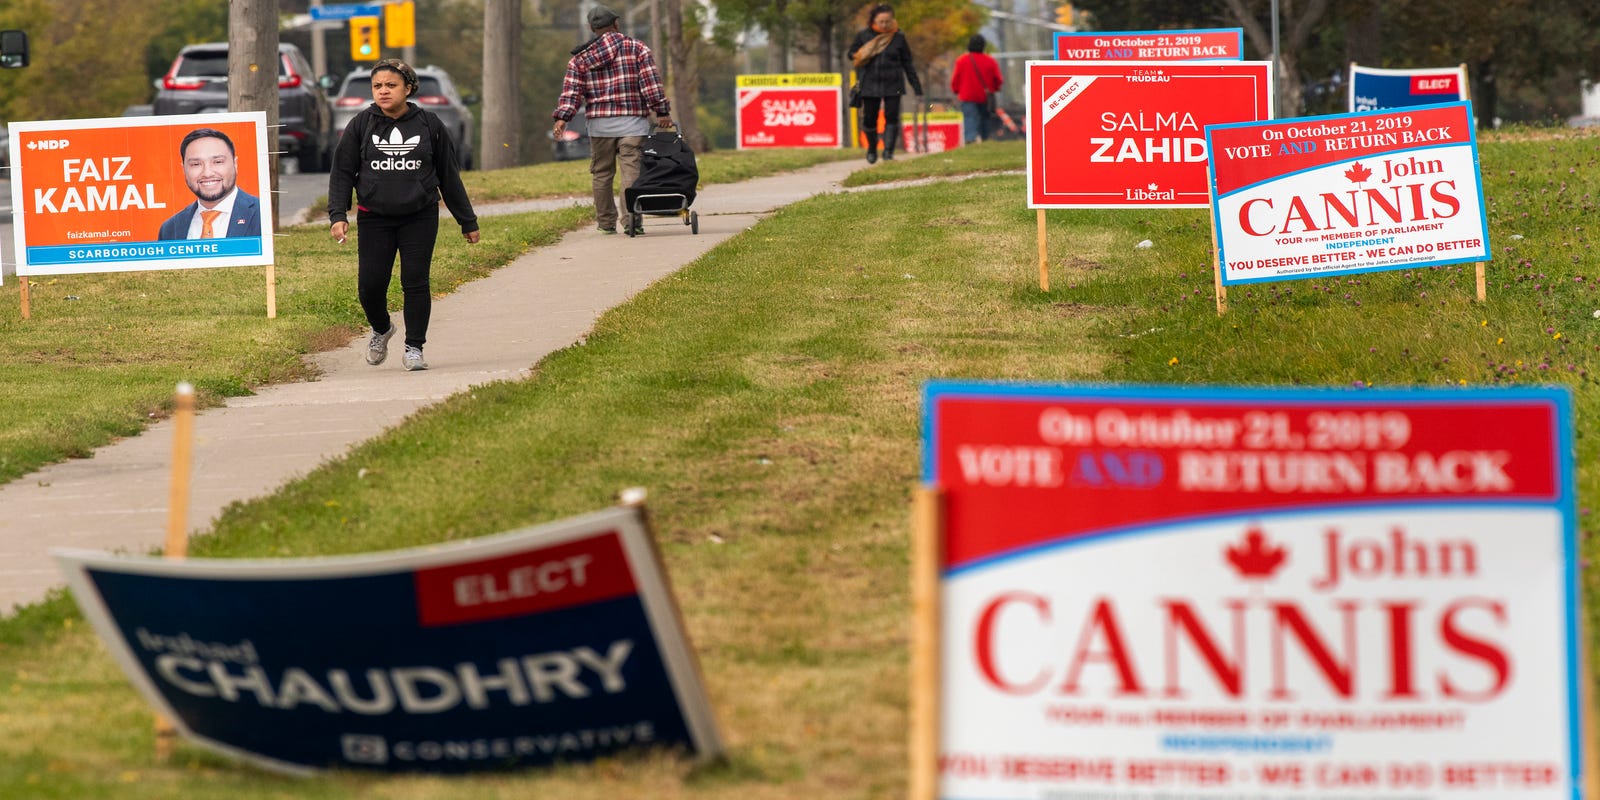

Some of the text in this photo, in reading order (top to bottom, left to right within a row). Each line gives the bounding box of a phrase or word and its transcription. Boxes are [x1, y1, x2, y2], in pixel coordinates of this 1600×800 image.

[1066, 45, 1227, 59] VOTE AND RETURN BACK
[1094, 38, 1111, 48] On
[1112, 37, 1155, 47] October
[1175, 35, 1202, 46] 2019
[1125, 75, 1171, 83] TRUDEAU
[1417, 78, 1452, 90] ELECT
[761, 98, 818, 113] SALMA
[1048, 81, 1080, 110] RE-ELECT
[763, 112, 816, 127] ZAHID
[1100, 110, 1199, 132] SALMA
[1262, 116, 1413, 141] On October 21, 2019
[38, 139, 70, 150] NDP
[1090, 137, 1209, 163] ZAHID
[1225, 126, 1452, 160] VOTE AND RETURN BACK
[63, 156, 133, 183] FAIZ
[370, 157, 422, 171] adidas
[1381, 156, 1444, 184] John
[34, 183, 166, 214] KAMAL
[1125, 187, 1175, 201] Liberal
[1238, 180, 1461, 237] CANNIS
[66, 229, 131, 240] faizkamal.com
[1275, 236, 1303, 246] YOUR
[1321, 231, 1363, 241] MEMBER
[1365, 229, 1379, 237] OF
[1381, 222, 1445, 235] PARLIAMENT
[1326, 236, 1395, 249] INDEPENDENT
[68, 243, 219, 259] SCARBOROUGH CENTRE
[1229, 260, 1254, 271] YOU
[1257, 255, 1309, 269] DESERVE
[1312, 251, 1356, 264] BETTER
[1366, 248, 1386, 259] WE
[1388, 245, 1414, 256] CAN
[1416, 243, 1434, 253] DO
[1436, 238, 1481, 251] BETTER
[1341, 262, 1357, 270] Agent
[1409, 255, 1436, 263] Campaign
[1040, 408, 1411, 449] On October 21, 2019
[958, 445, 1513, 493] VOTE AND RETURN BACK
[1312, 526, 1478, 591] John
[453, 553, 593, 608] ELECT
[972, 591, 1513, 702] CANNIS
[153, 637, 635, 715] CHAUDHRY
[392, 719, 655, 762] CONSERVATIVE
